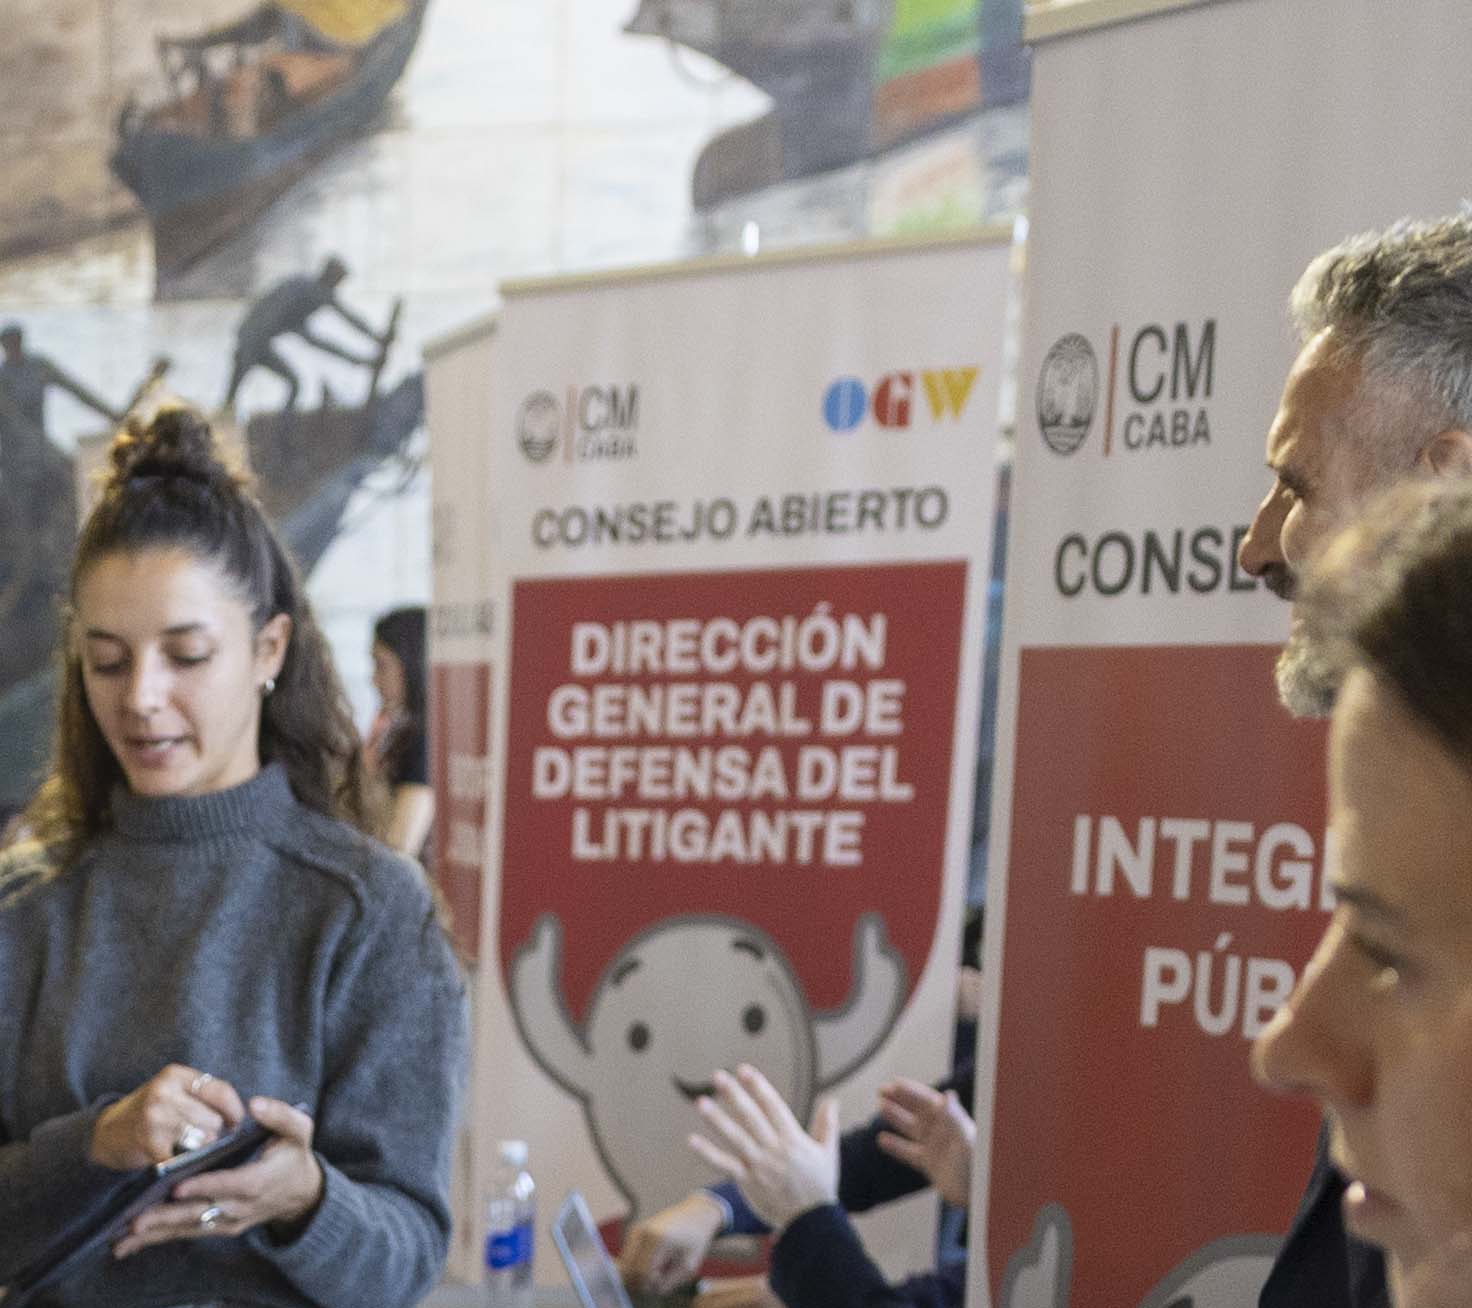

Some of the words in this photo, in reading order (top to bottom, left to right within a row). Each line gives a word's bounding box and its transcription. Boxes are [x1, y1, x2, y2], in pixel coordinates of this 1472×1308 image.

[1127, 319, 1218, 404] CM
[577, 383, 640, 431] CM
[1123, 406, 1211, 452] CABA
[532, 497, 737, 550] CONSEJO
[747, 485, 952, 540] ABIERTO
[570, 602, 888, 677] DIRECCIÓN
[548, 683, 811, 739] GENERAL
[821, 680, 906, 736] DE
[532, 747, 788, 799] DEFENSA
[797, 746, 914, 802] DEL
[571, 808, 864, 866] LITIGANTE
